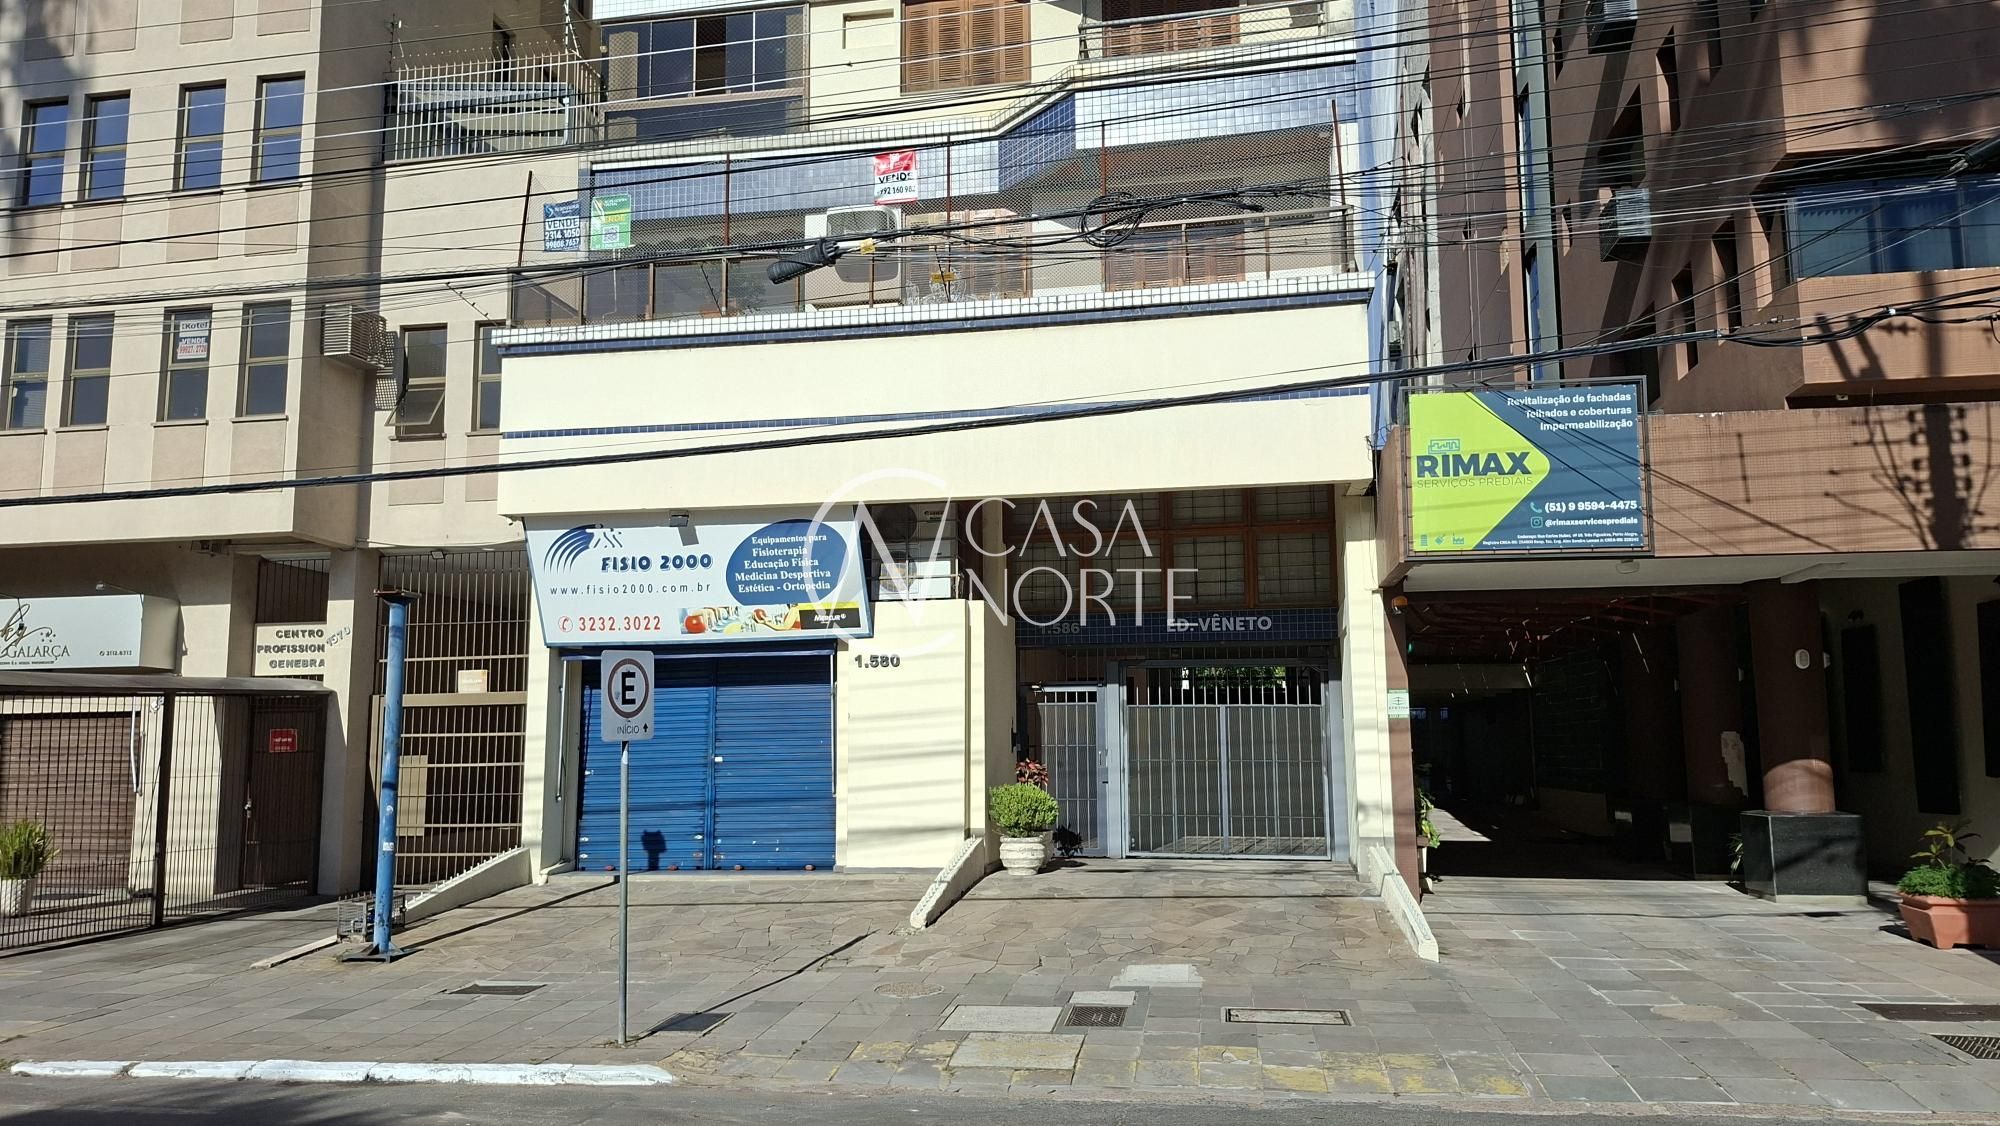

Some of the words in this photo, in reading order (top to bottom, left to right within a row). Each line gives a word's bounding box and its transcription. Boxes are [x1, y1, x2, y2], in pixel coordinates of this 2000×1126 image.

[546, 219, 579, 230] VENDE
[1507, 395, 1571, 406] Revitalização
[1573, 393, 1585, 403] de
[1587, 392, 1632, 402] fachadas
[1579, 406, 1632, 416] coberturas
[1540, 418, 1633, 431] Impermeabilização
[1416, 452, 1532, 478] RIMAX
[1417, 478, 1475, 488] SERVIÇOS
[1479, 476, 1533, 486] PREDIAIS
[1545, 502, 1566, 513] (51)
[1568, 502, 1576, 511] 9
[1577, 500, 1637, 510] 9594-4475
[752, 535, 806, 544] Equipamentos
[808, 534, 827, 543] para
[752, 547, 808, 557] Fisioterapia
[601, 556, 651, 572] FISIO
[659, 553, 713, 570] 2000
[744, 559, 790, 570] Educação
[791, 557, 819, 567] Física
[735, 572, 778, 581] Medicina
[780, 569, 831, 579] Desportiva
[550, 582, 711, 595] www.fisio2000.com.br
[738, 583, 775, 593] Estética
[783, 581, 831, 591] Ortopedia
[579, 615, 661, 632] 3232.3022
[1039, 623, 1081, 635] 1.586
[1167, 618, 1195, 632] ED.
[1198, 614, 1272, 632] VÊNETO
[275, 629, 324, 638] CENTRO
[7, 645, 71, 661] GALARÇA
[257, 644, 325, 653] PROFISSION
[269, 659, 325, 669] GENEBRA
[854, 654, 901, 668] 1.580
[621, 671, 636, 705] E
[616, 724, 640, 734] INÍCIO
